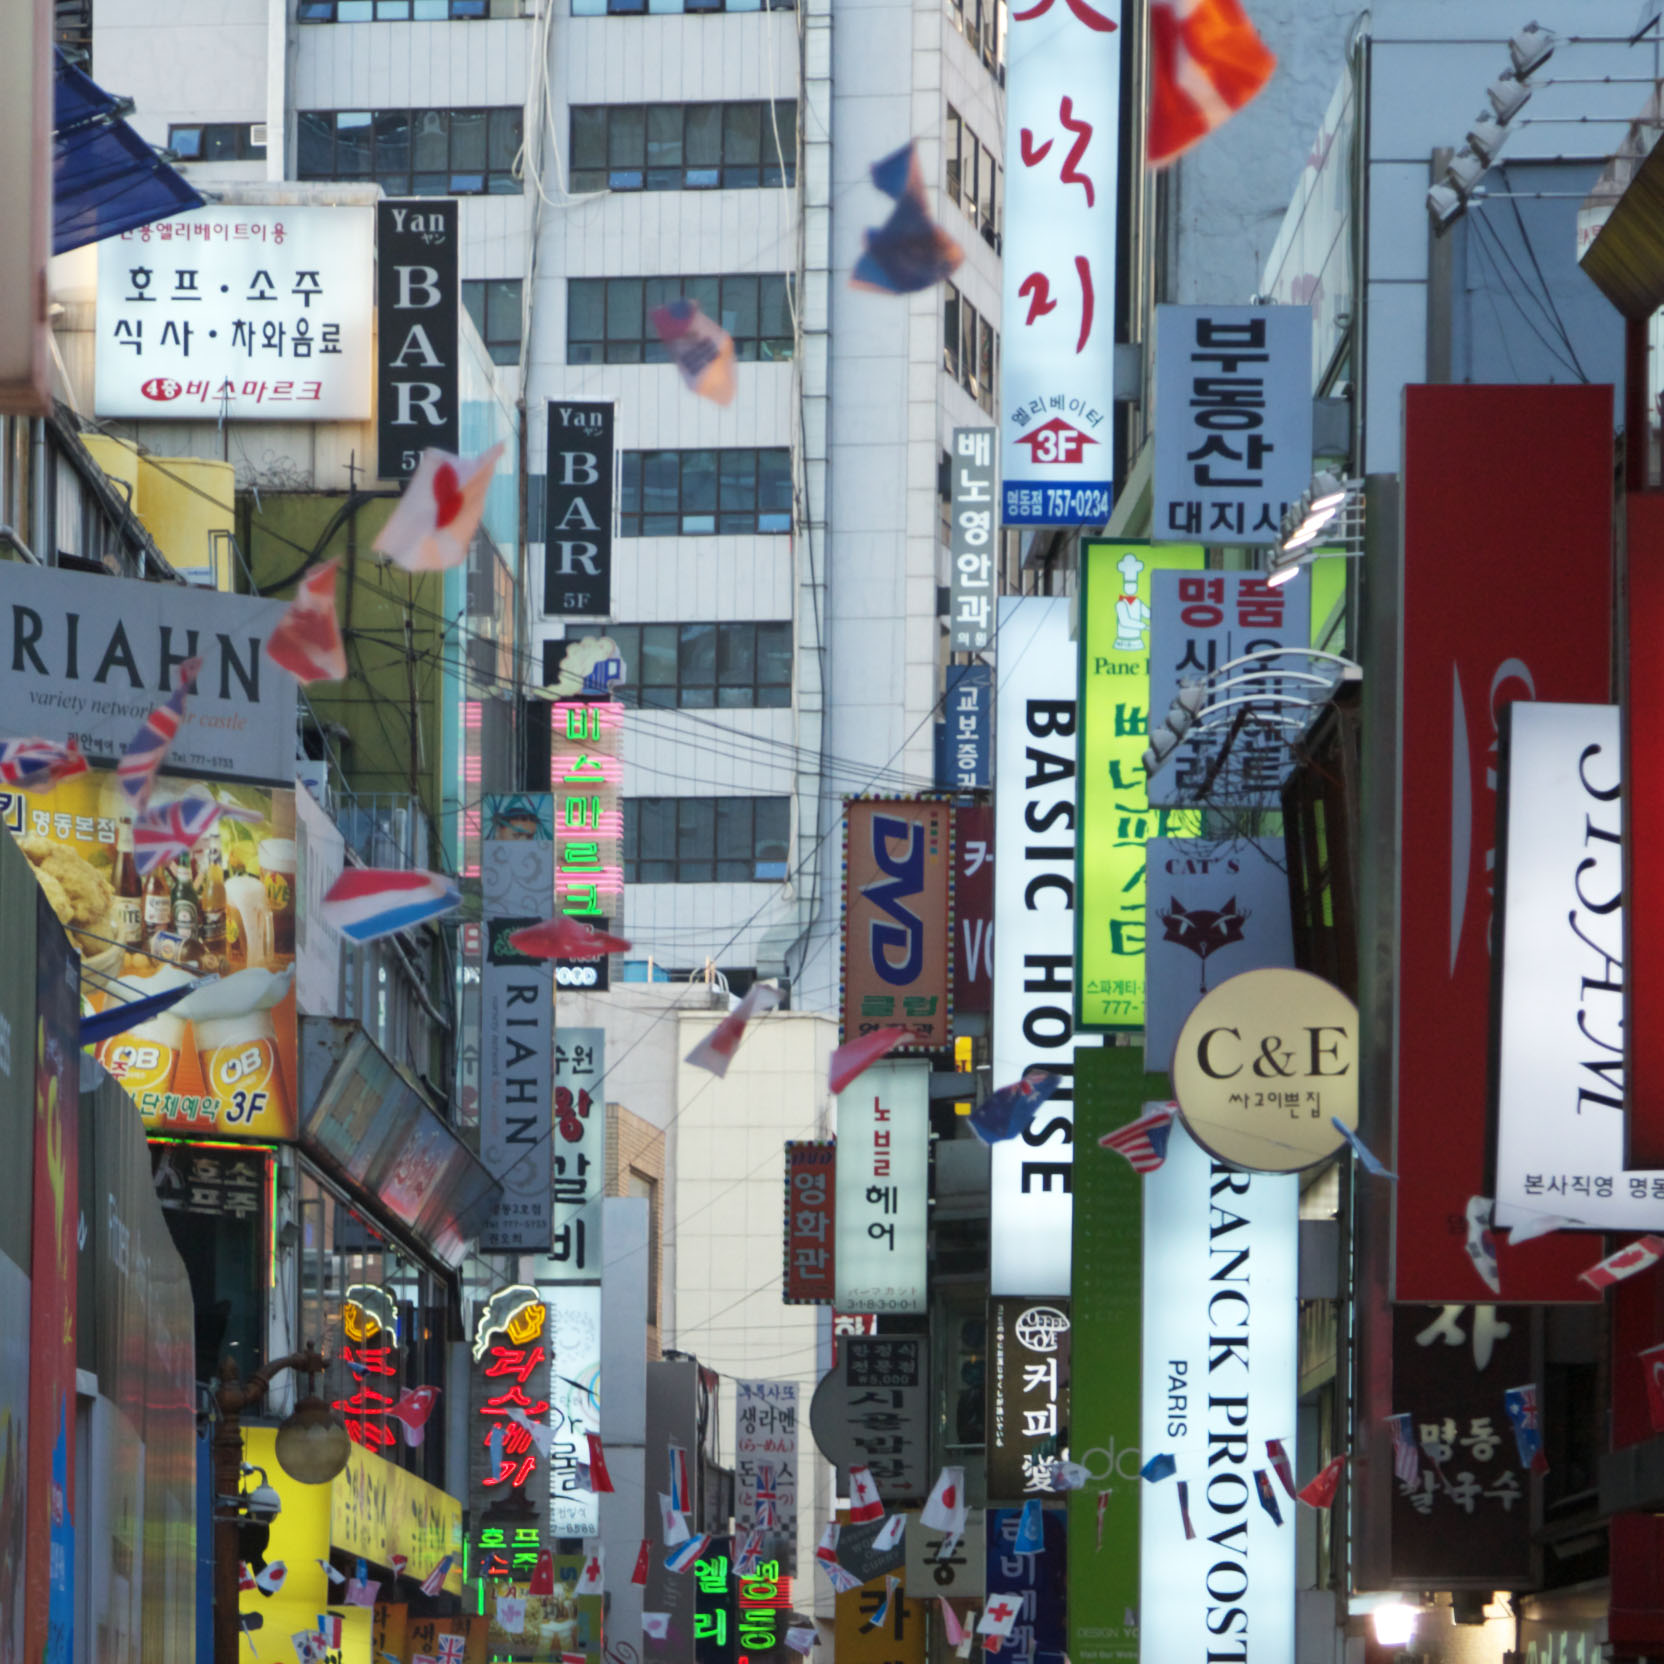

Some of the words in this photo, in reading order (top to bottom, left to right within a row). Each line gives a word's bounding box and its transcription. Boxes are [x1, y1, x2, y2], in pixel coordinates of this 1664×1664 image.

[393, 209, 445, 231] Yan
[125, 266, 202, 302] 호프
[246, 270, 323, 307] 소주
[114, 320, 194, 357] 식사
[232, 317, 343, 358] 차와음료
[389, 266, 448, 425] BAR
[186, 380, 323, 404] 비스마르크
[1011, 394, 1104, 428] 엘리베이터
[1187, 317, 1274, 488] 부동산
[559, 408, 602, 427] Yan
[402, 451, 424, 471] 5
[1037, 430, 1078, 462] 3F
[557, 452, 604, 575] BAR
[1007, 489, 1042, 517] 명동점
[1047, 488, 1109, 516] 757-0234
[957, 432, 992, 629] 배노영안과
[563, 592, 591, 609] 5F
[1178, 576, 1284, 628] 명품
[11, 604, 262, 704] RIAHN
[1093, 657, 1140, 676] Pane
[30, 689, 87, 716] variety
[562, 708, 603, 915] 비스마르크
[1025, 699, 1076, 911] BASIC
[32, 811, 117, 844] 명동본점
[1165, 857, 1241, 876] CAT'S
[858, 811, 925, 986] DVD
[112, 1046, 161, 1071] OB
[220, 1046, 262, 1085] OB
[506, 984, 539, 1145] RIAHN
[1197, 1026, 1350, 1079] C&E
[1022, 954, 1073, 1195] HOUSE
[141, 1092, 220, 1122] 단체예약
[226, 1091, 267, 1124] 3F
[872, 1096, 892, 1178] 노블
[1523, 1175, 1615, 1199] 본사직영
[794, 1172, 830, 1280] 영화관
[866, 1184, 898, 1251] 헤어
[1208, 1162, 1253, 1384] RANCK
[1022, 1356, 1058, 1438] 커피
[1167, 1359, 1188, 1438] PARIS
[739, 1406, 795, 1434] 생라멘
[1419, 1416, 1502, 1465] 명동
[739, 1460, 795, 1488] 돈스
[478, 1528, 540, 1549] 호프
